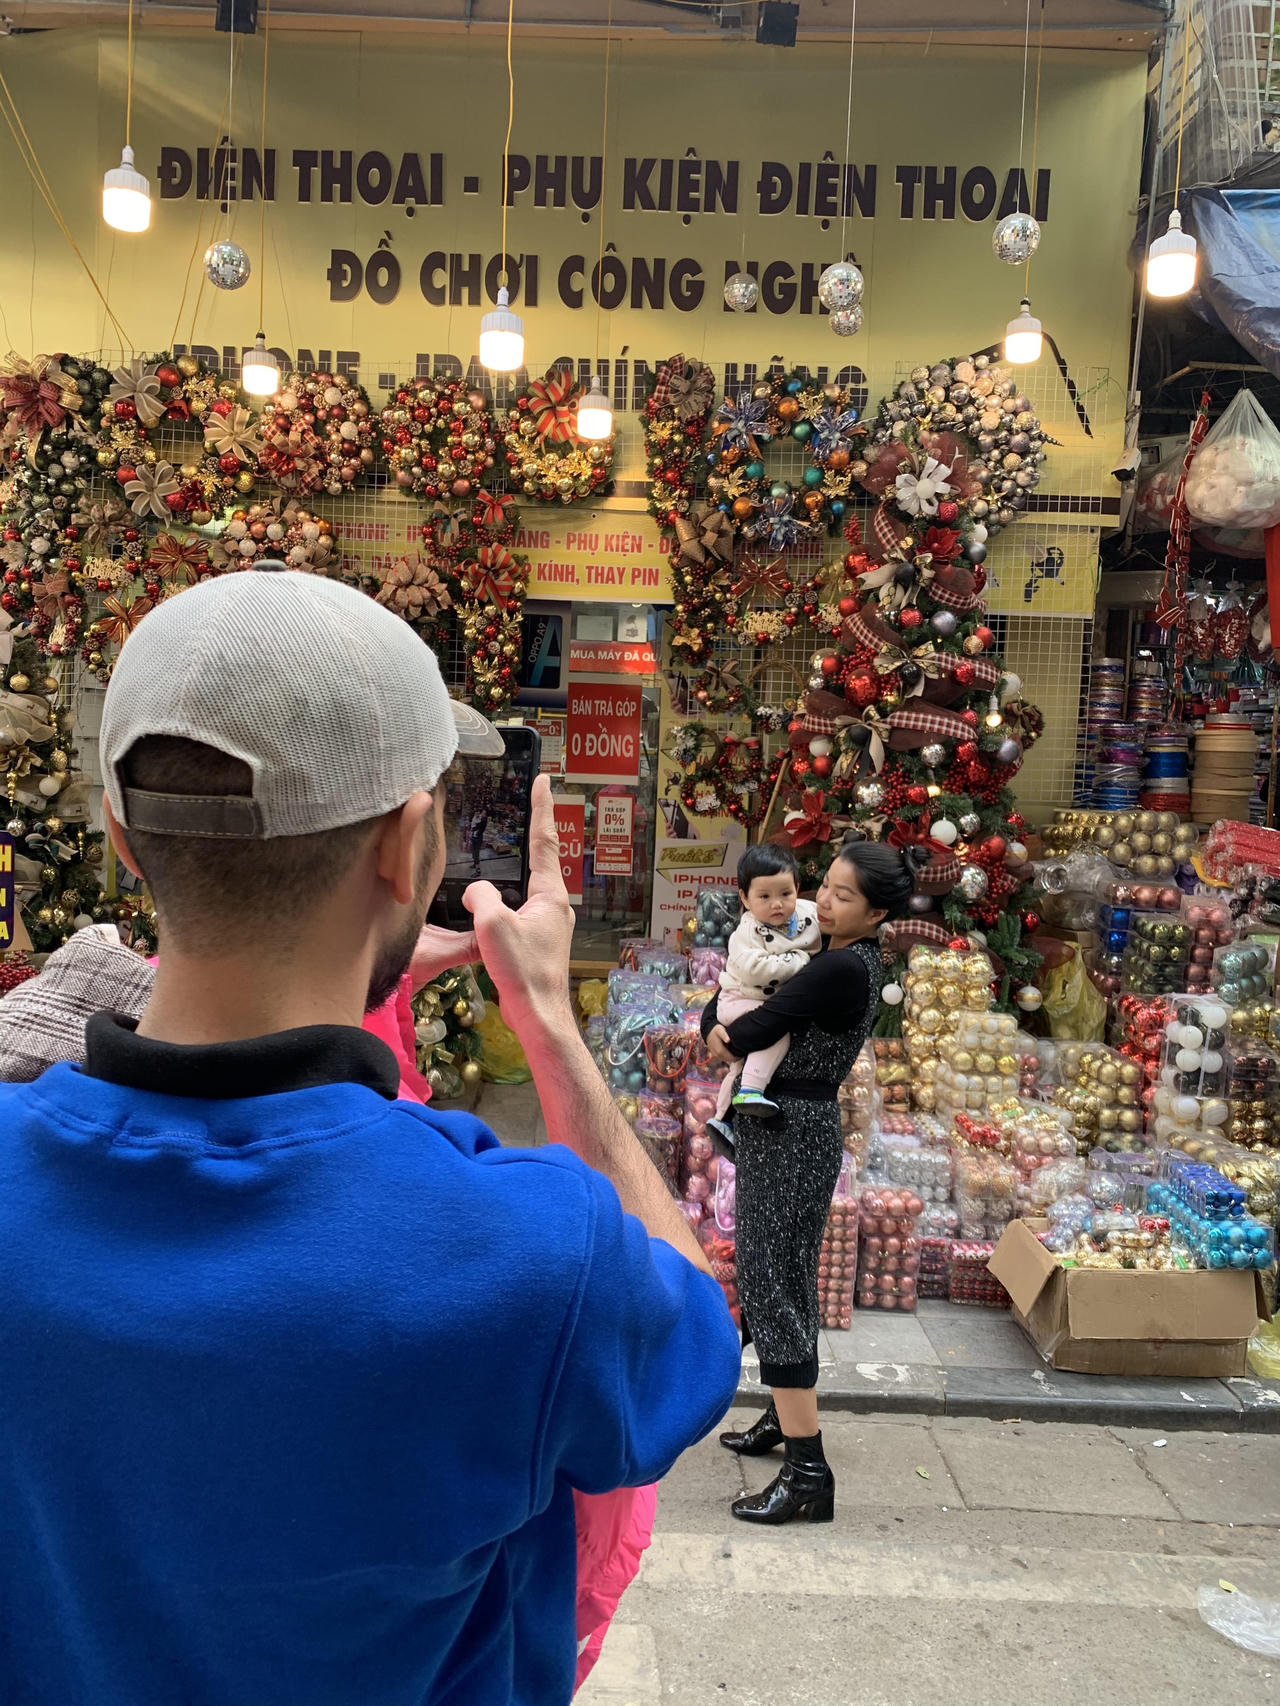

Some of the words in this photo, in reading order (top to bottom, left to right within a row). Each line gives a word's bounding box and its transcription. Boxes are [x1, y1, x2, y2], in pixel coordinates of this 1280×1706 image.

[157, 135, 277, 214] ĐIỆN
[292, 149, 445, 218] THOẠI
[501, 154, 603, 223] PHỤ
[623, 146, 740, 226] KIỆN
[757, 150, 878, 231] ĐIỆN
[327, 230, 401, 304] ĐỒ
[420, 251, 538, 307] CHƠI
[557, 242, 705, 312] CÔNG
[723, 252, 862, 315] NGH
[566, 532, 600, 556] PHỤ
[604, 531, 643, 557] KIỆN
[537, 560, 580, 585] KÍNH,
[585, 565, 627, 585] THAY
[631, 568, 660, 587] PIN
[528, 636, 543, 663] OPPO
[570, 650, 595, 660] MUA
[597, 648, 622, 661] MÁY
[624, 650, 640, 662] ĐÃ
[572, 695, 592, 716] BÁN
[616, 698, 637, 718] GÓP
[585, 722, 634, 759] ĐỒNG
[604, 813, 625, 826] 0%
